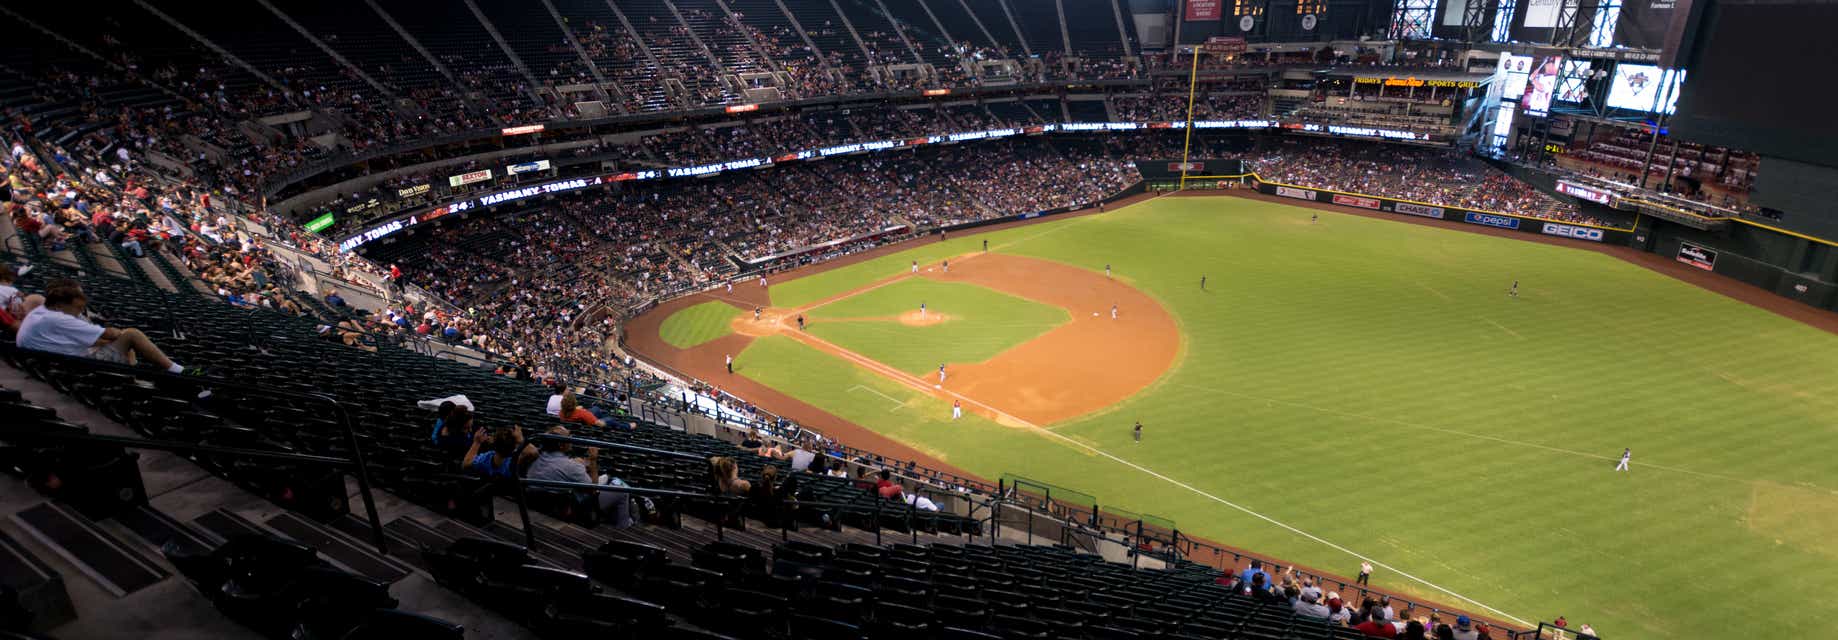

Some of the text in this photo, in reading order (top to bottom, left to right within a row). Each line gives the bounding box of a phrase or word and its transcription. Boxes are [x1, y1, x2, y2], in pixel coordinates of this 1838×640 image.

[1328, 126, 1376, 136] YASMANY
[1379, 130, 1416, 140] TOMAS
[820, 144, 861, 156] YASMANY
[862, 141, 894, 150] TOMAS
[668, 164, 723, 177] YASMANY
[725, 158, 760, 169] TOMAS
[480, 186, 539, 206] YASMANY
[541, 179, 587, 193] TOMAS
[1399, 204, 1430, 215] CHASE
[1483, 215, 1512, 228] pepsi
[365, 221, 403, 241] TOMAS
[1544, 223, 1601, 241] GEICO
